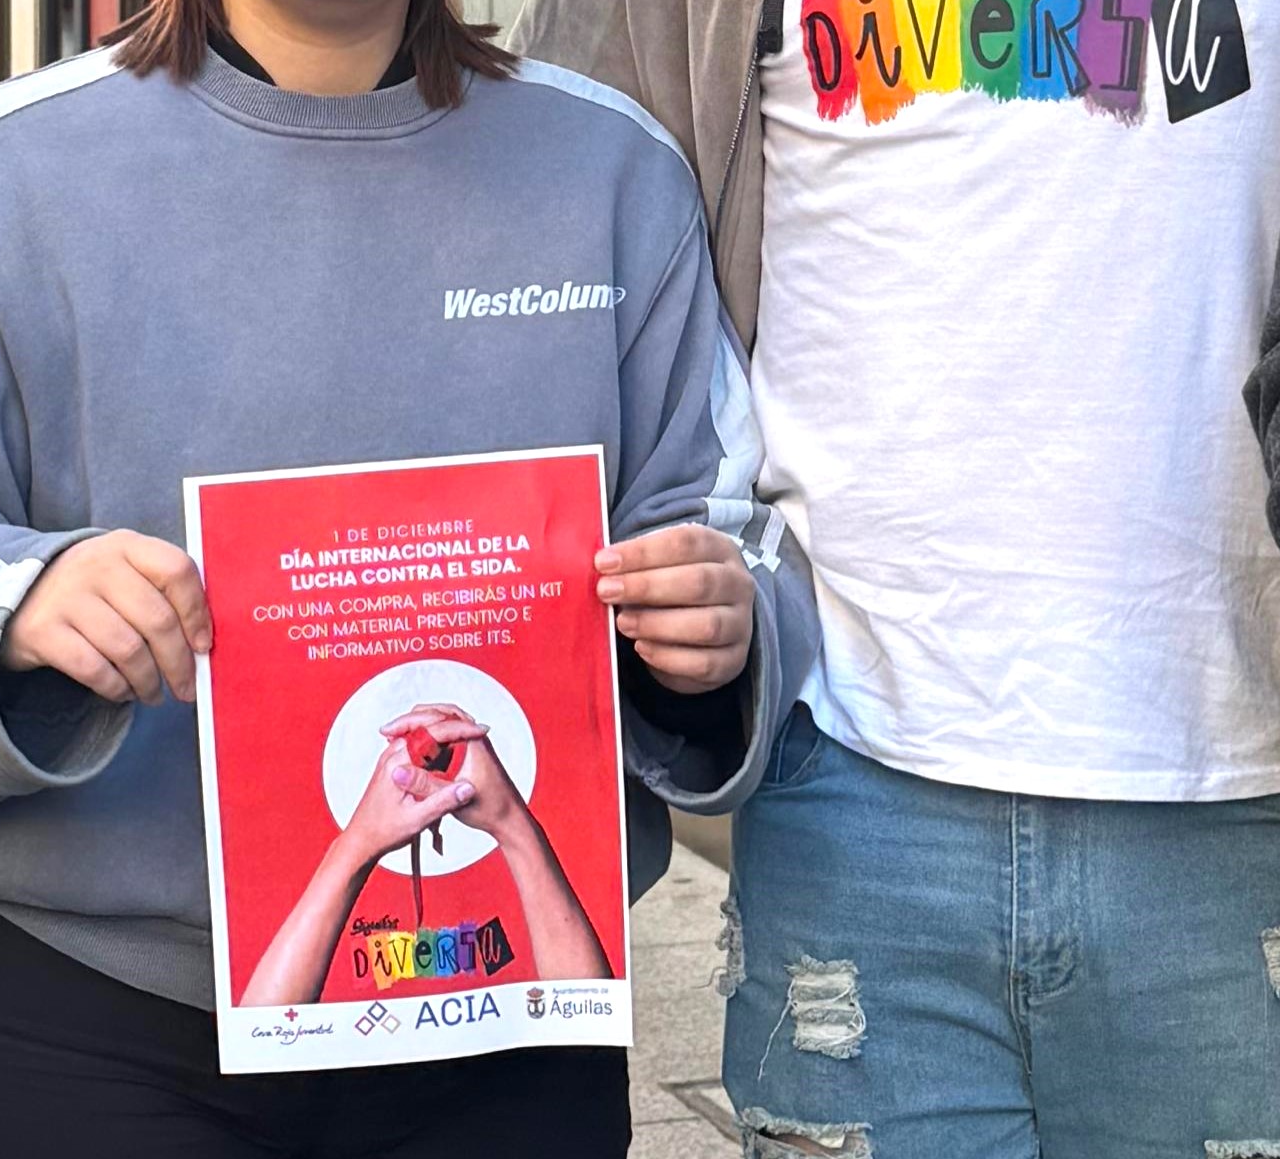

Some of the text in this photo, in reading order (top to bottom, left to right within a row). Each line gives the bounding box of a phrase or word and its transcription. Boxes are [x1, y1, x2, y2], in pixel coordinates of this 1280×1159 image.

[347, 528, 369, 542] DE
[377, 519, 474, 539] DICIEMBRE
[280, 534, 530, 570] DÍA INTERNACIONAL DE LA
[291, 557, 521, 591] LUCHA CONTRA EL SIDA.
[253, 581, 564, 622] CON UNA COMPRA, RECIBIRÁS UN KIT
[288, 606, 532, 641] CON MATERIAL PREVENTIVO E
[308, 628, 515, 661] INFORMATIVO SOBRE ITS.
[415, 992, 500, 1030] ACIA
[550, 994, 613, 1018] Águilas
